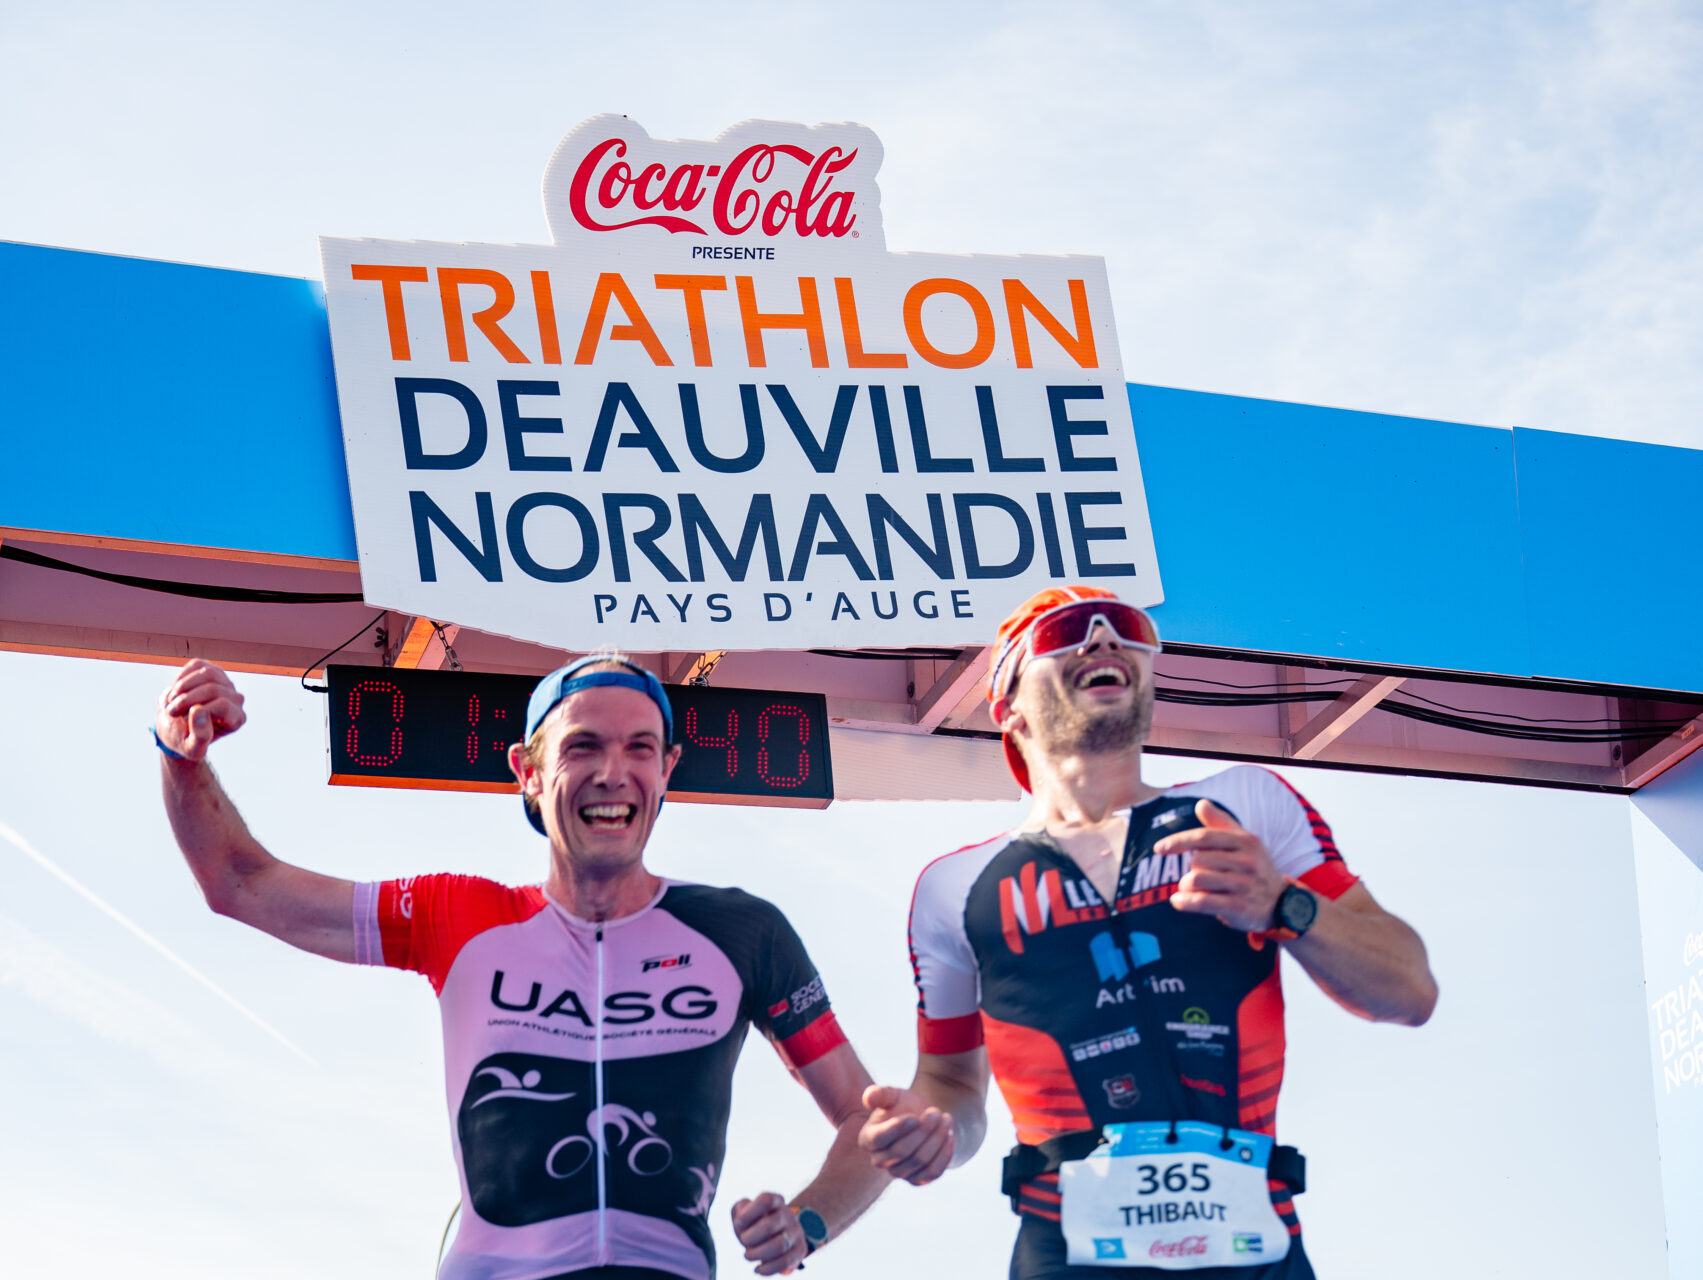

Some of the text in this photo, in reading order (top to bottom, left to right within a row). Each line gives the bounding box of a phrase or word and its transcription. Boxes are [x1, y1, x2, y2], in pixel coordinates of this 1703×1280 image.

[569, 138, 859, 237] Coca-Cola
[691, 246, 776, 260] PRESENTE
[351, 264, 1099, 369] TRIATHLON
[394, 377, 1119, 473] DEAUVILLE
[408, 491, 1137, 583] NORMANDIE
[595, 589, 975, 623] PAYS D'AUGE
[490, 969, 719, 1028] UASG
[488, 1018, 521, 1027] UNION
[1136, 1162, 1212, 1195] 365
[1118, 1201, 1228, 1227] THIBAUT
